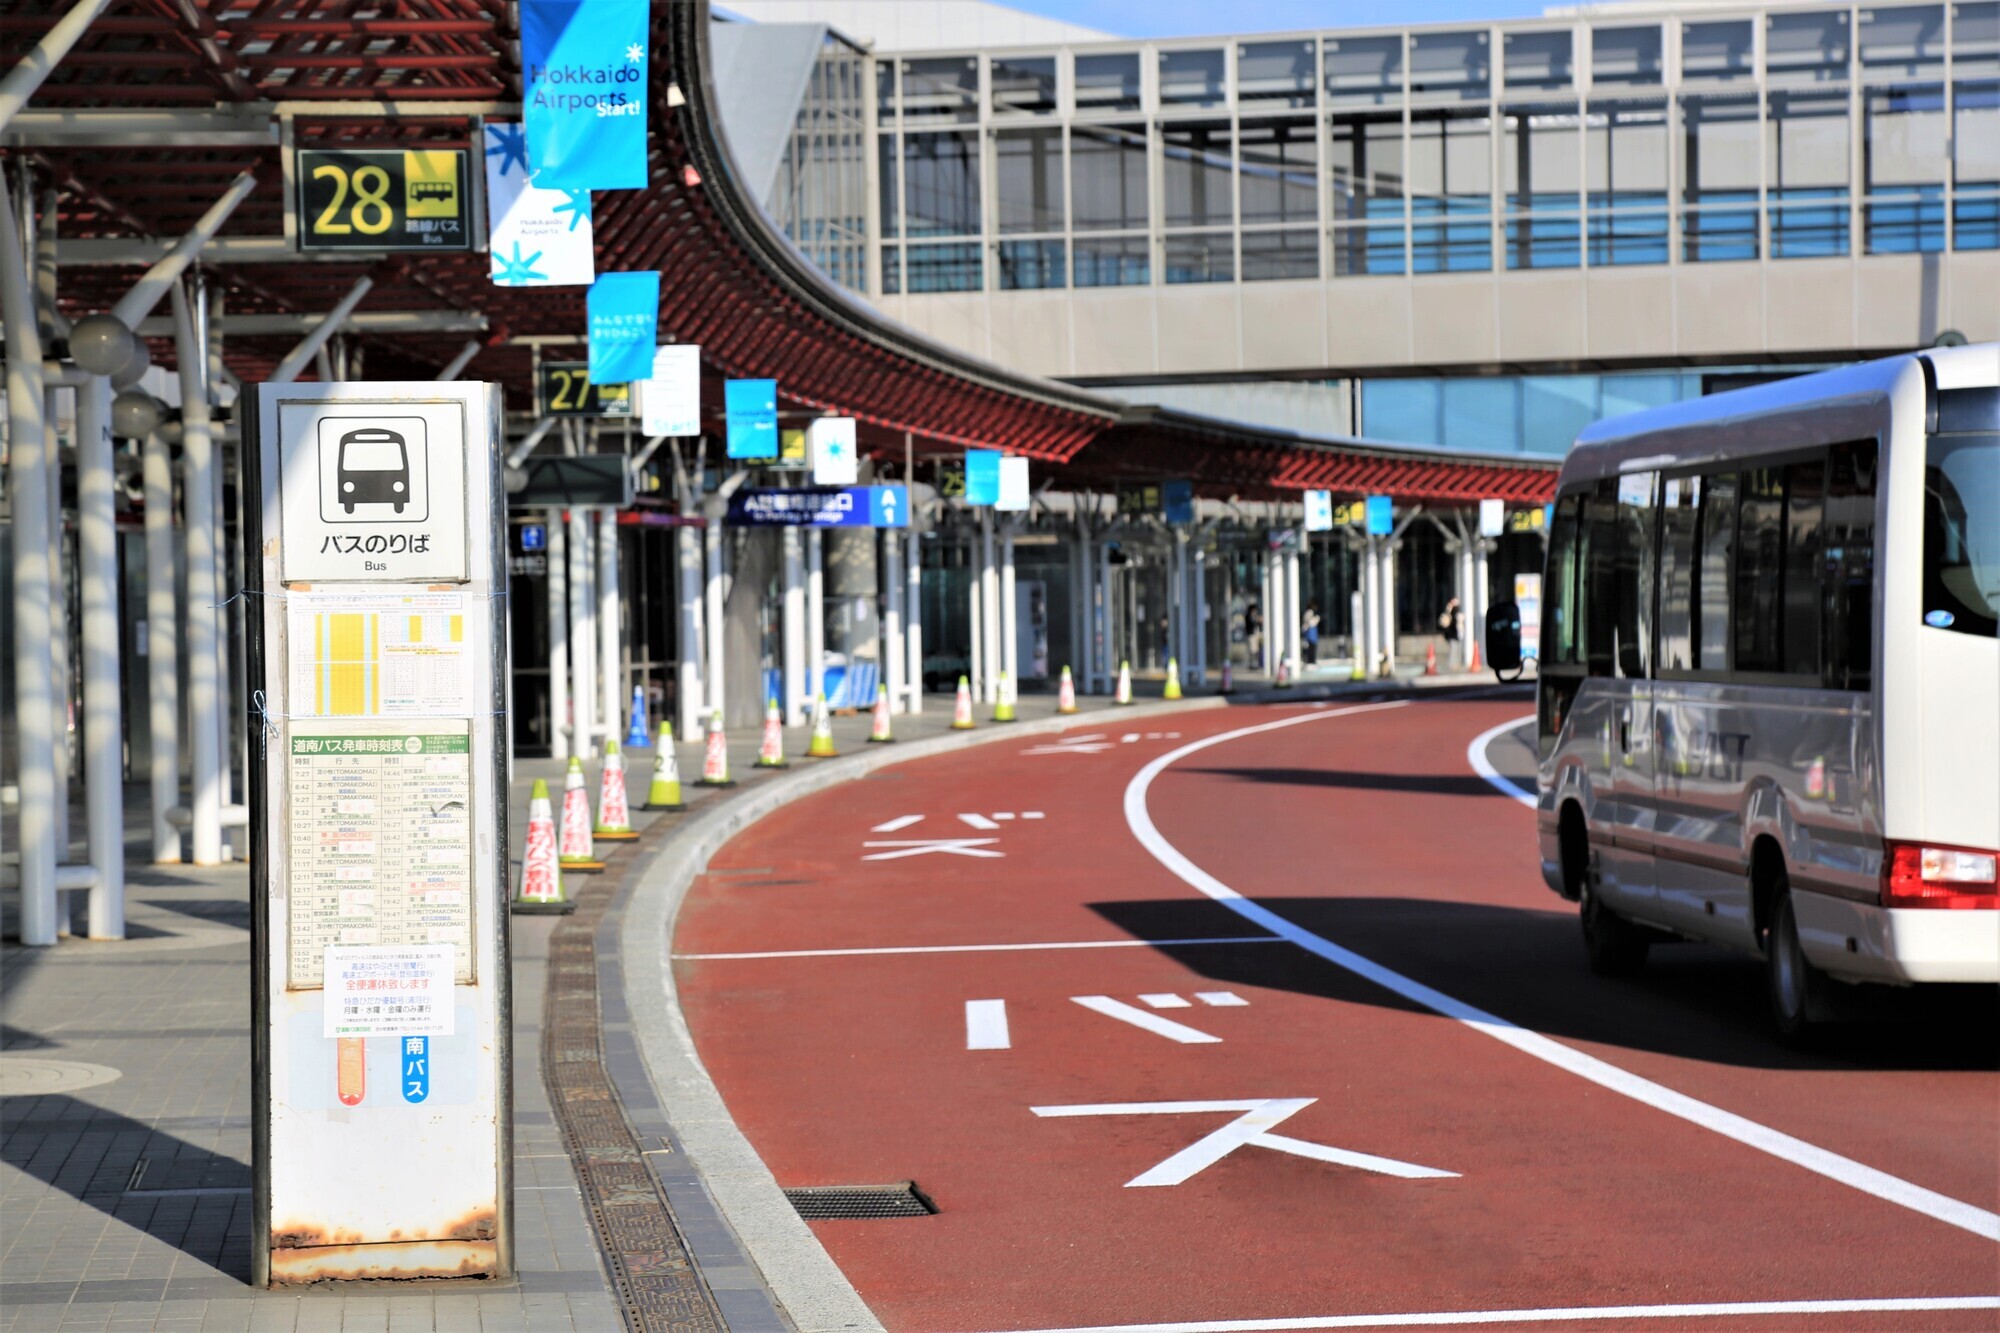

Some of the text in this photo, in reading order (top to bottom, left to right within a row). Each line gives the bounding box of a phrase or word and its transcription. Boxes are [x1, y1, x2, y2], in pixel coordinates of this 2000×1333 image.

[530, 64, 640, 84] Hokkaido
[533, 89, 627, 113] Airports
[596, 100, 640, 118] Start!
[313, 165, 394, 235] 28
[405, 219, 460, 233] 路線バス
[422, 233, 443, 244] Bus
[551, 370, 590, 410] 27
[320, 534, 430, 554] バスのりば
[365, 561, 387, 571] Bus
[293, 739, 404, 753] 道南バス発車時刻表
[653, 755, 678, 774] 27
[346, 979, 430, 991] 全便運休致します
[344, 1005, 432, 1014] 月曜・水曜・金曜のみ運行
[406, 1037, 425, 1097] 南バス
[965, 991, 1464, 1188] バス
